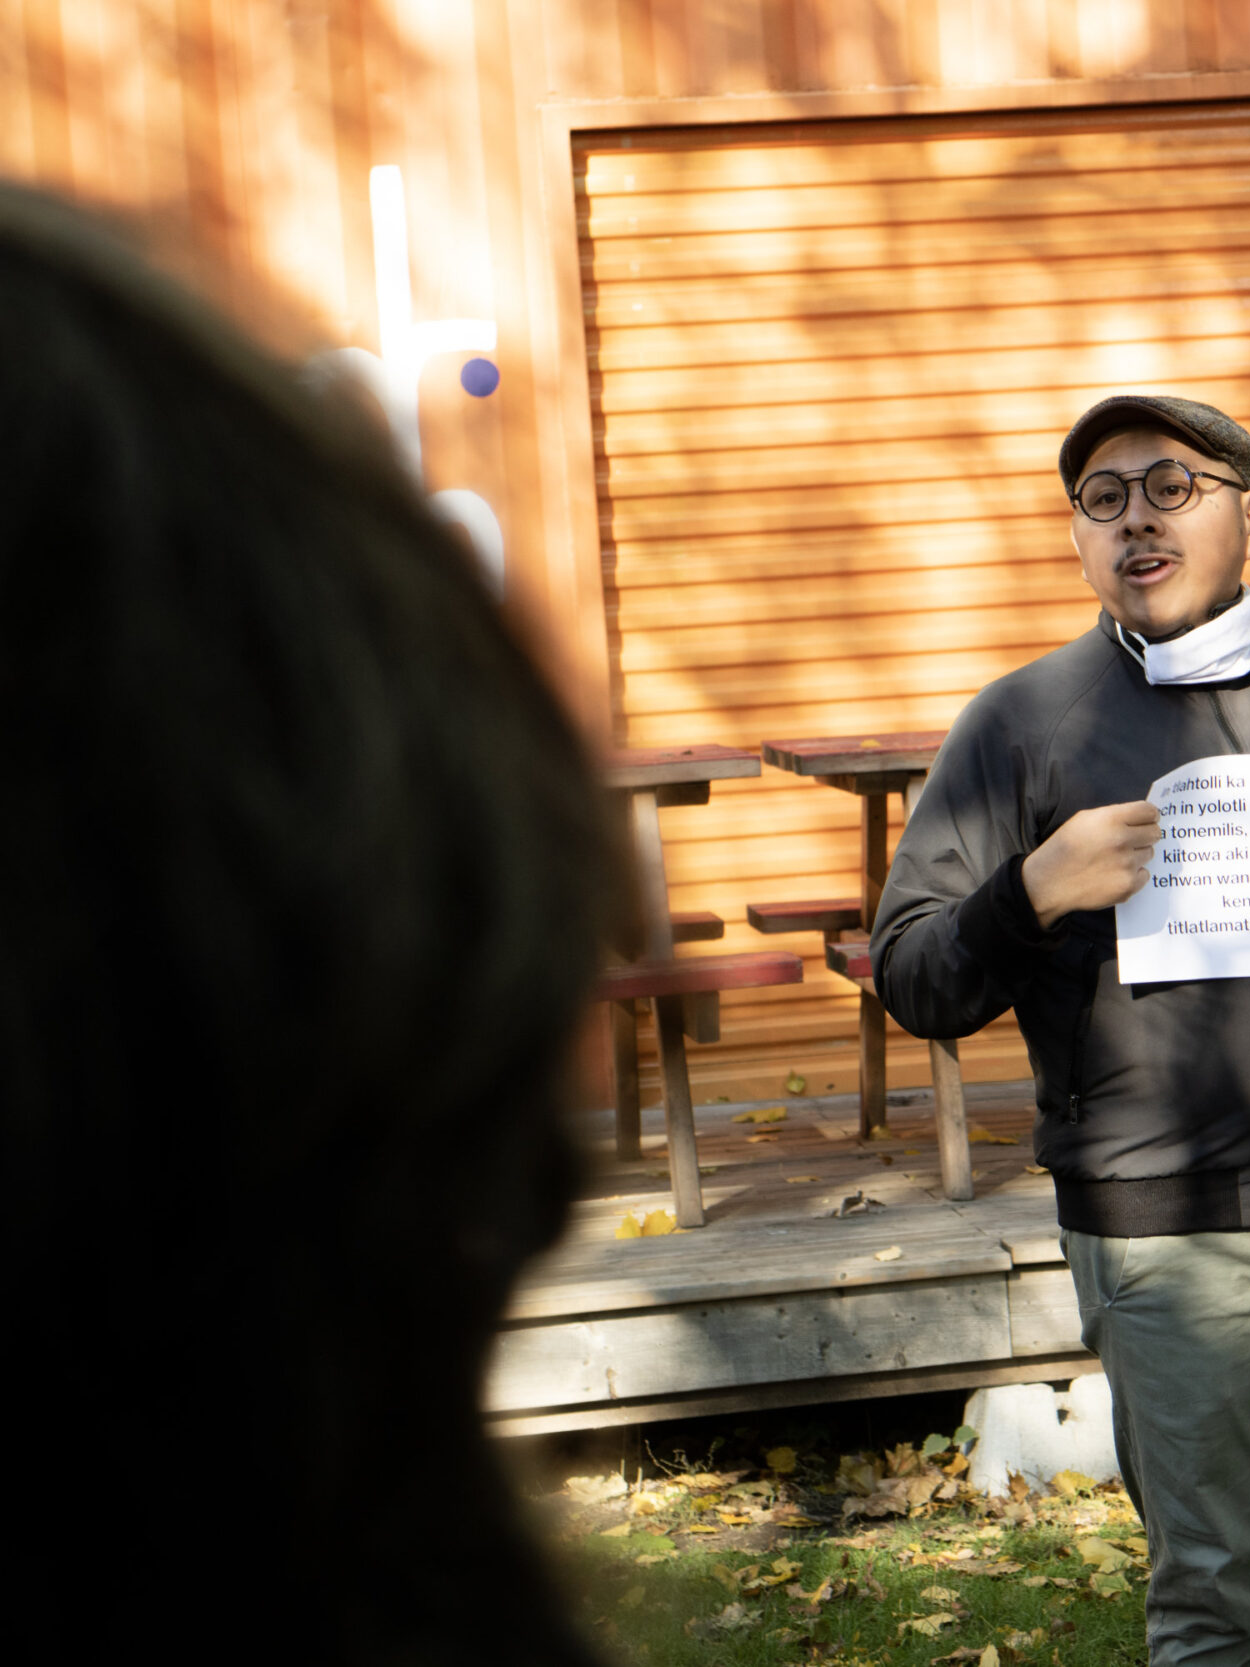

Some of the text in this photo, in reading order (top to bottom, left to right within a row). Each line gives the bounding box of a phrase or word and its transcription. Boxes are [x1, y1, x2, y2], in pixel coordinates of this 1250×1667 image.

[1226, 775, 1245, 788] ka
[1158, 798, 1246, 817] ch in yolotli
[1163, 846, 1249, 864] kiitowa aki
[1152, 873, 1250, 888] tehwan wan
